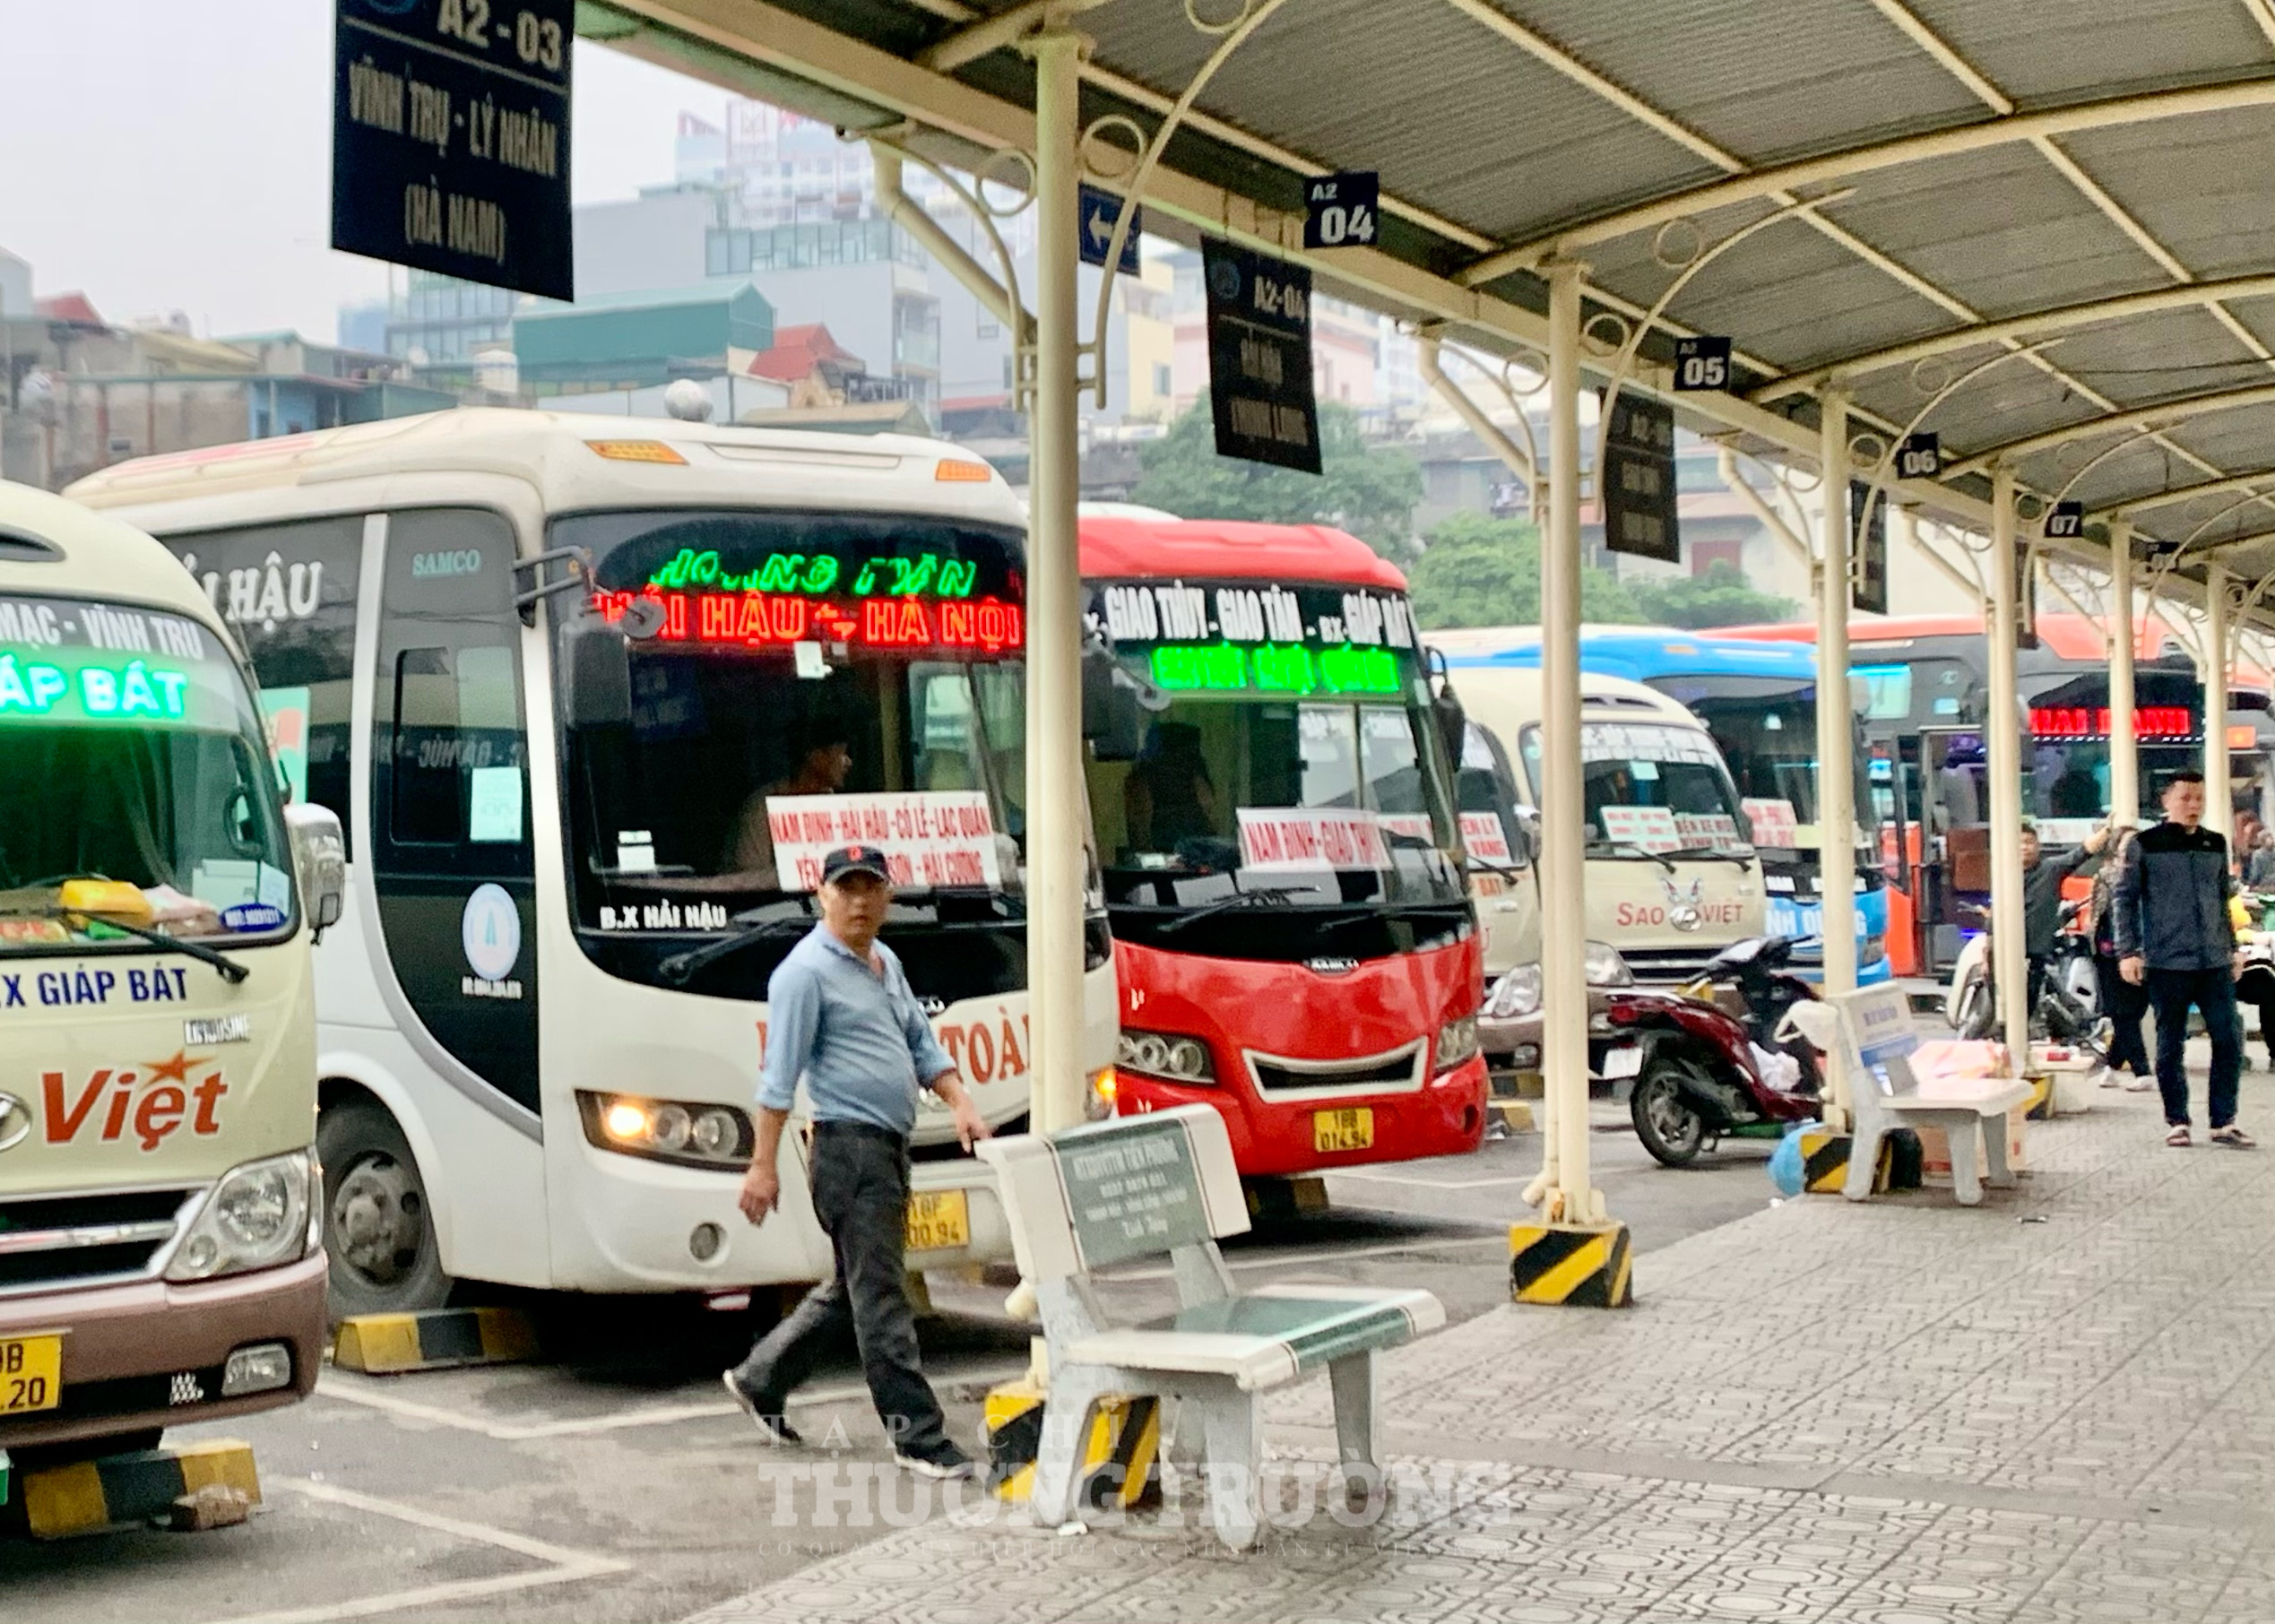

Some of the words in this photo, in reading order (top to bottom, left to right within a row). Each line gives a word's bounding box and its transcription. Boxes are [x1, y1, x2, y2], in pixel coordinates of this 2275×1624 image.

[470, 91, 495, 160] LÝ
[499, 106, 557, 177] NHÂN
[1311, 182, 1338, 202] A2
[1319, 204, 1375, 245] 04
[1682, 356, 1726, 387] 05
[1904, 449, 1937, 474] 06
[2051, 514, 2079, 535] 07
[412, 549, 481, 575] SAMCO
[228, 550, 324, 632] HẬU
[1104, 586, 1158, 640] GIAO
[1216, 588, 1265, 641] GIAO
[79, 603, 151, 654] VĨNH
[702, 588, 806, 645] HẬU
[865, 592, 930, 644] HÀ
[941, 596, 1020, 652] NỘI
[80, 660, 187, 716] BÁT
[38, 963, 116, 1005] GIÁP
[128, 962, 187, 1001] BÁT
[939, 1005, 1030, 1084] TOÀ
